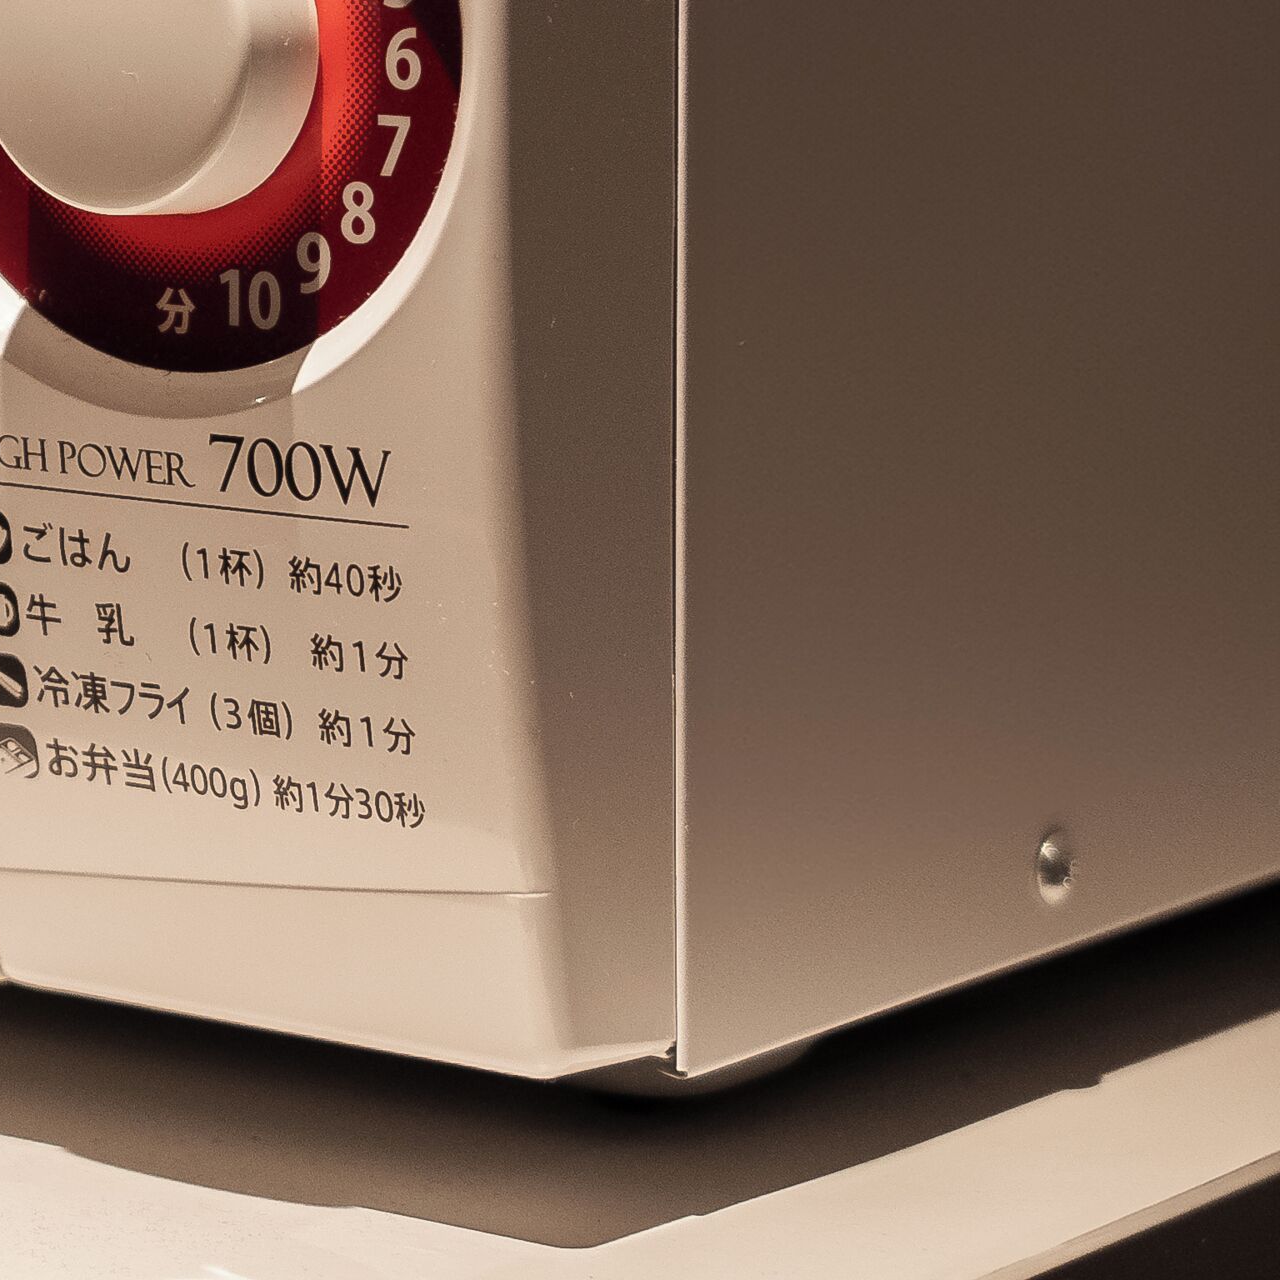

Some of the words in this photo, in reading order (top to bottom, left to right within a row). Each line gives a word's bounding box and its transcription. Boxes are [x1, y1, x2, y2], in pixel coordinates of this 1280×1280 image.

[385, 27, 422, 91] 6
[377, 114, 411, 177] 7
[341, 181, 376, 244] 8
[296, 232, 332, 294] 9
[156, 287, 196, 335] 分
[220, 269, 281, 331] 10
[58, 440, 196, 488] POWER
[209, 433, 391, 508] 700W
[22, 522, 131, 574] ごはん
[288, 555, 403, 604] 約40秒
[310, 633, 408, 680] 約1分
[33, 665, 191, 726] 冷凍フライ
[318, 708, 416, 756] 約1分
[273, 774, 426, 829] 約1分30秒
